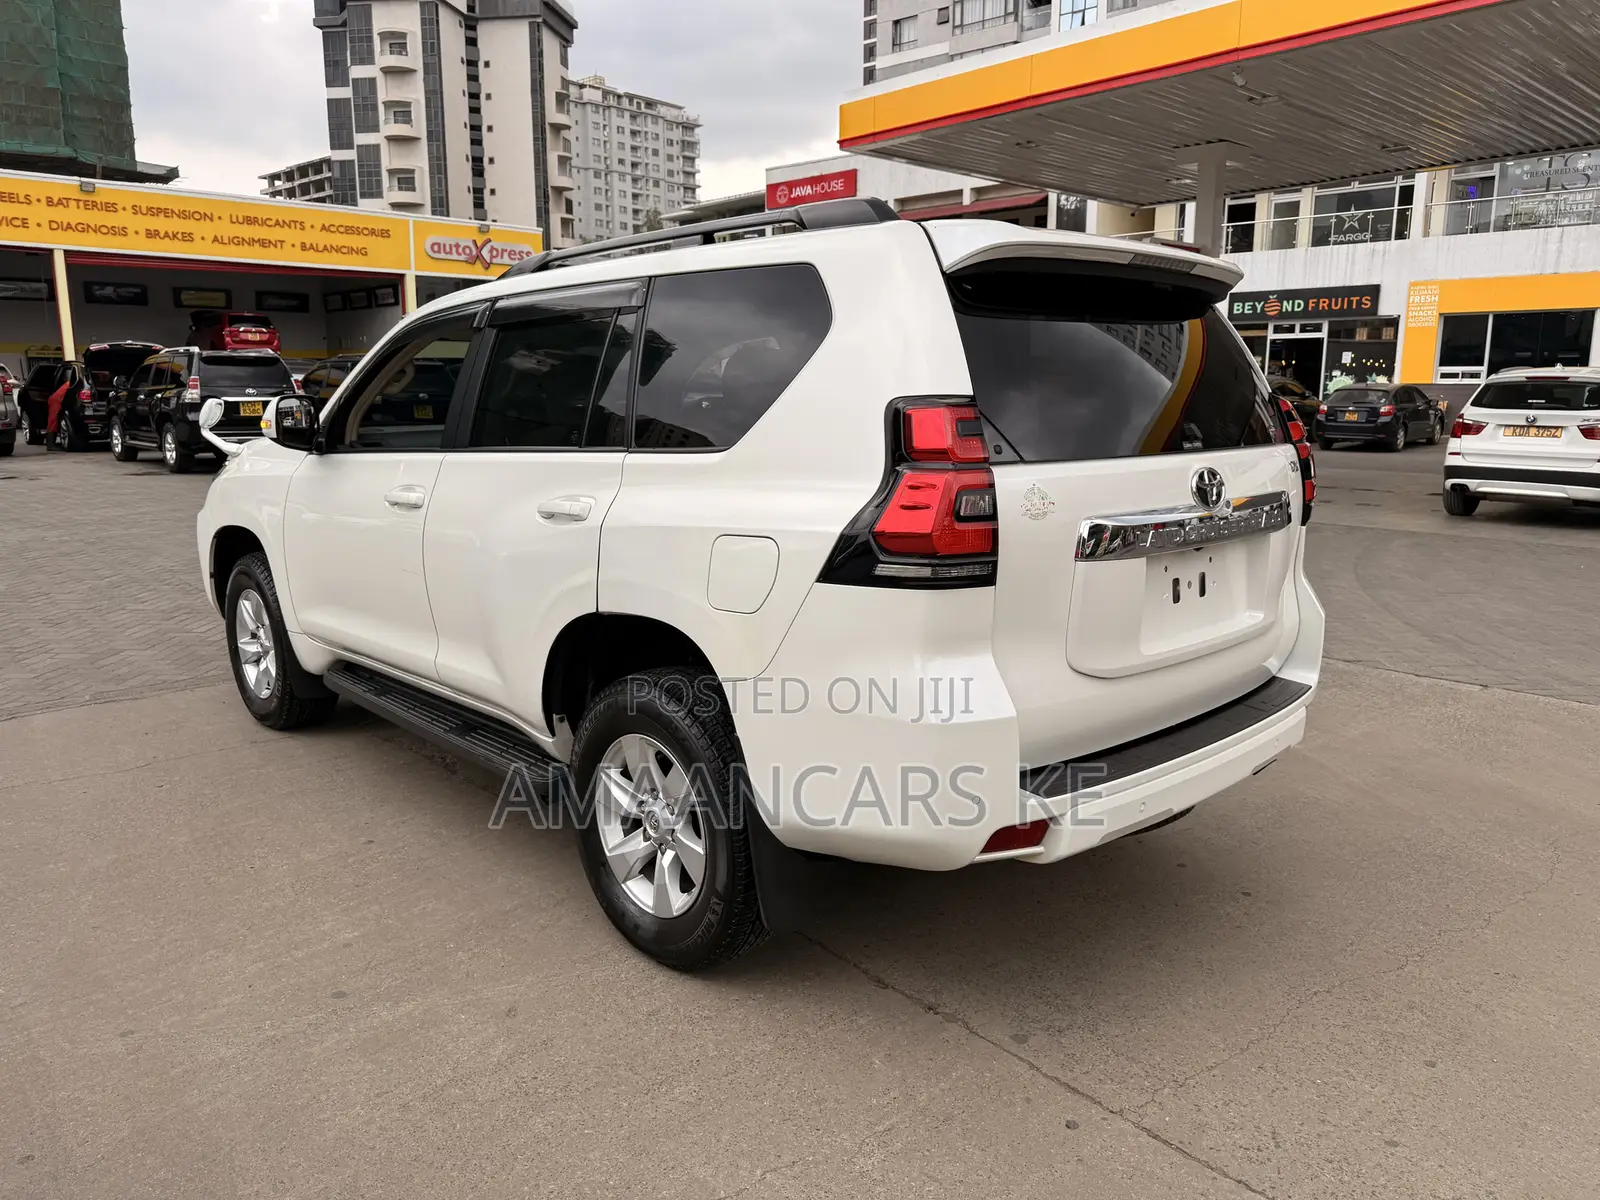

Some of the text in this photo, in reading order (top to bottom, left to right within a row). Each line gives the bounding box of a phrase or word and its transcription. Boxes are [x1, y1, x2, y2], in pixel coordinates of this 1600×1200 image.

[1525, 167, 1571, 178] TREASURED
[45, 196, 118, 213] BATTERIES
[131, 204, 214, 222] SUSPENSION
[229, 213, 305, 230] LUBRICANTS
[319, 223, 391, 239] ACCESSORIES
[48, 220, 128, 236] DIAGNOSIS
[145, 228, 194, 242] BRAKES
[211, 235, 286, 250] ALIGNMENT
[301, 242, 368, 257] BALANCING
[1308, 296, 1372, 310] FRUITS
[1410, 295, 1439, 303] FRESH
[1512, 426, 1530, 436] KDA
